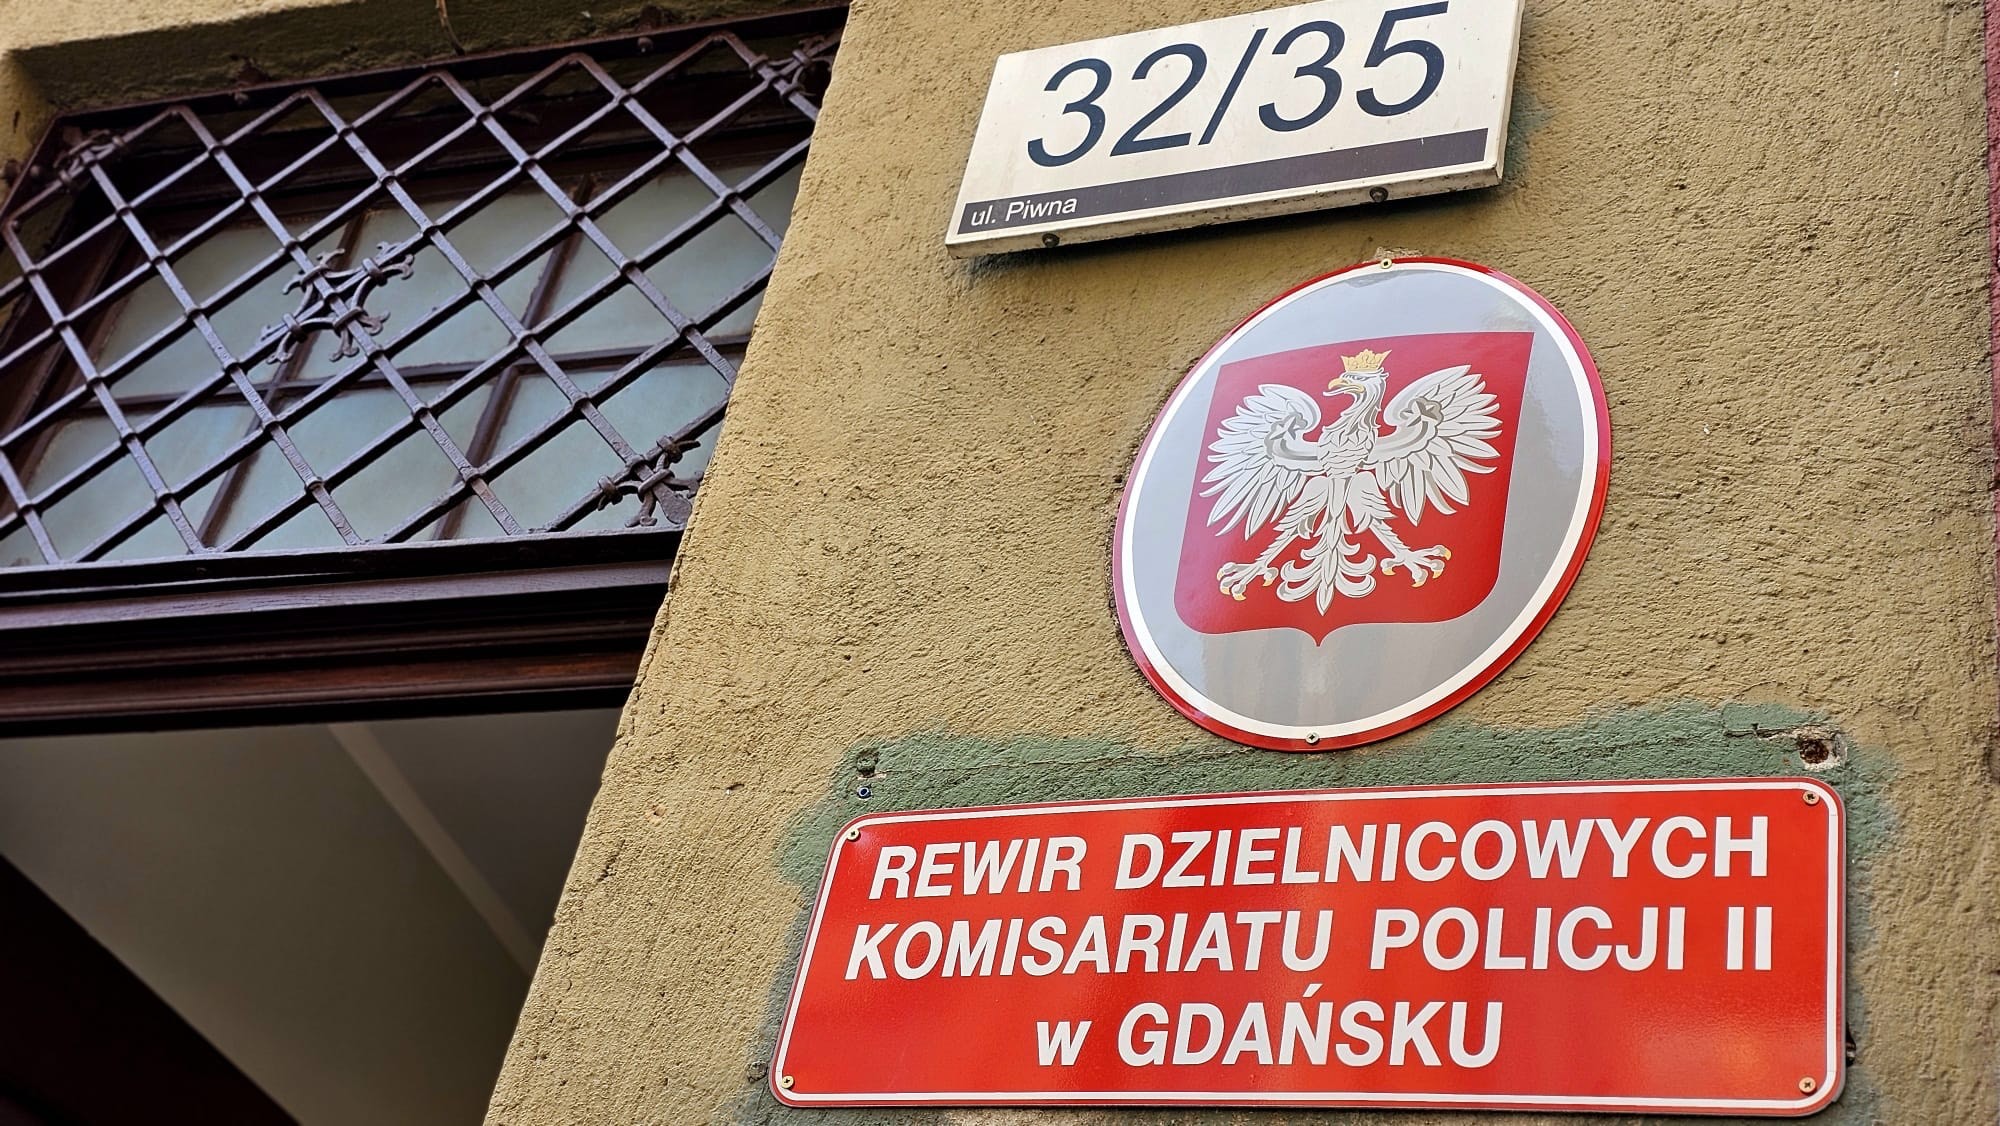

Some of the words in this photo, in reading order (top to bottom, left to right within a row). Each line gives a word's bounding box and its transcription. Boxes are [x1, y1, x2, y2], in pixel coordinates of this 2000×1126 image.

[1027, 1, 1448, 168] 32/35
[970, 205, 996, 226] ul.
[1004, 198, 1078, 222] Piwna
[868, 836, 1088, 900] REWIR
[1114, 815, 1769, 890] DZIELNICOWYCH
[844, 906, 1334, 981] KOMISARIATU
[1370, 905, 1686, 971] POLICJI
[1726, 906, 1773, 971] II
[1036, 1020, 1093, 1066] w
[1117, 984, 1503, 1068] GDAŃSKU
